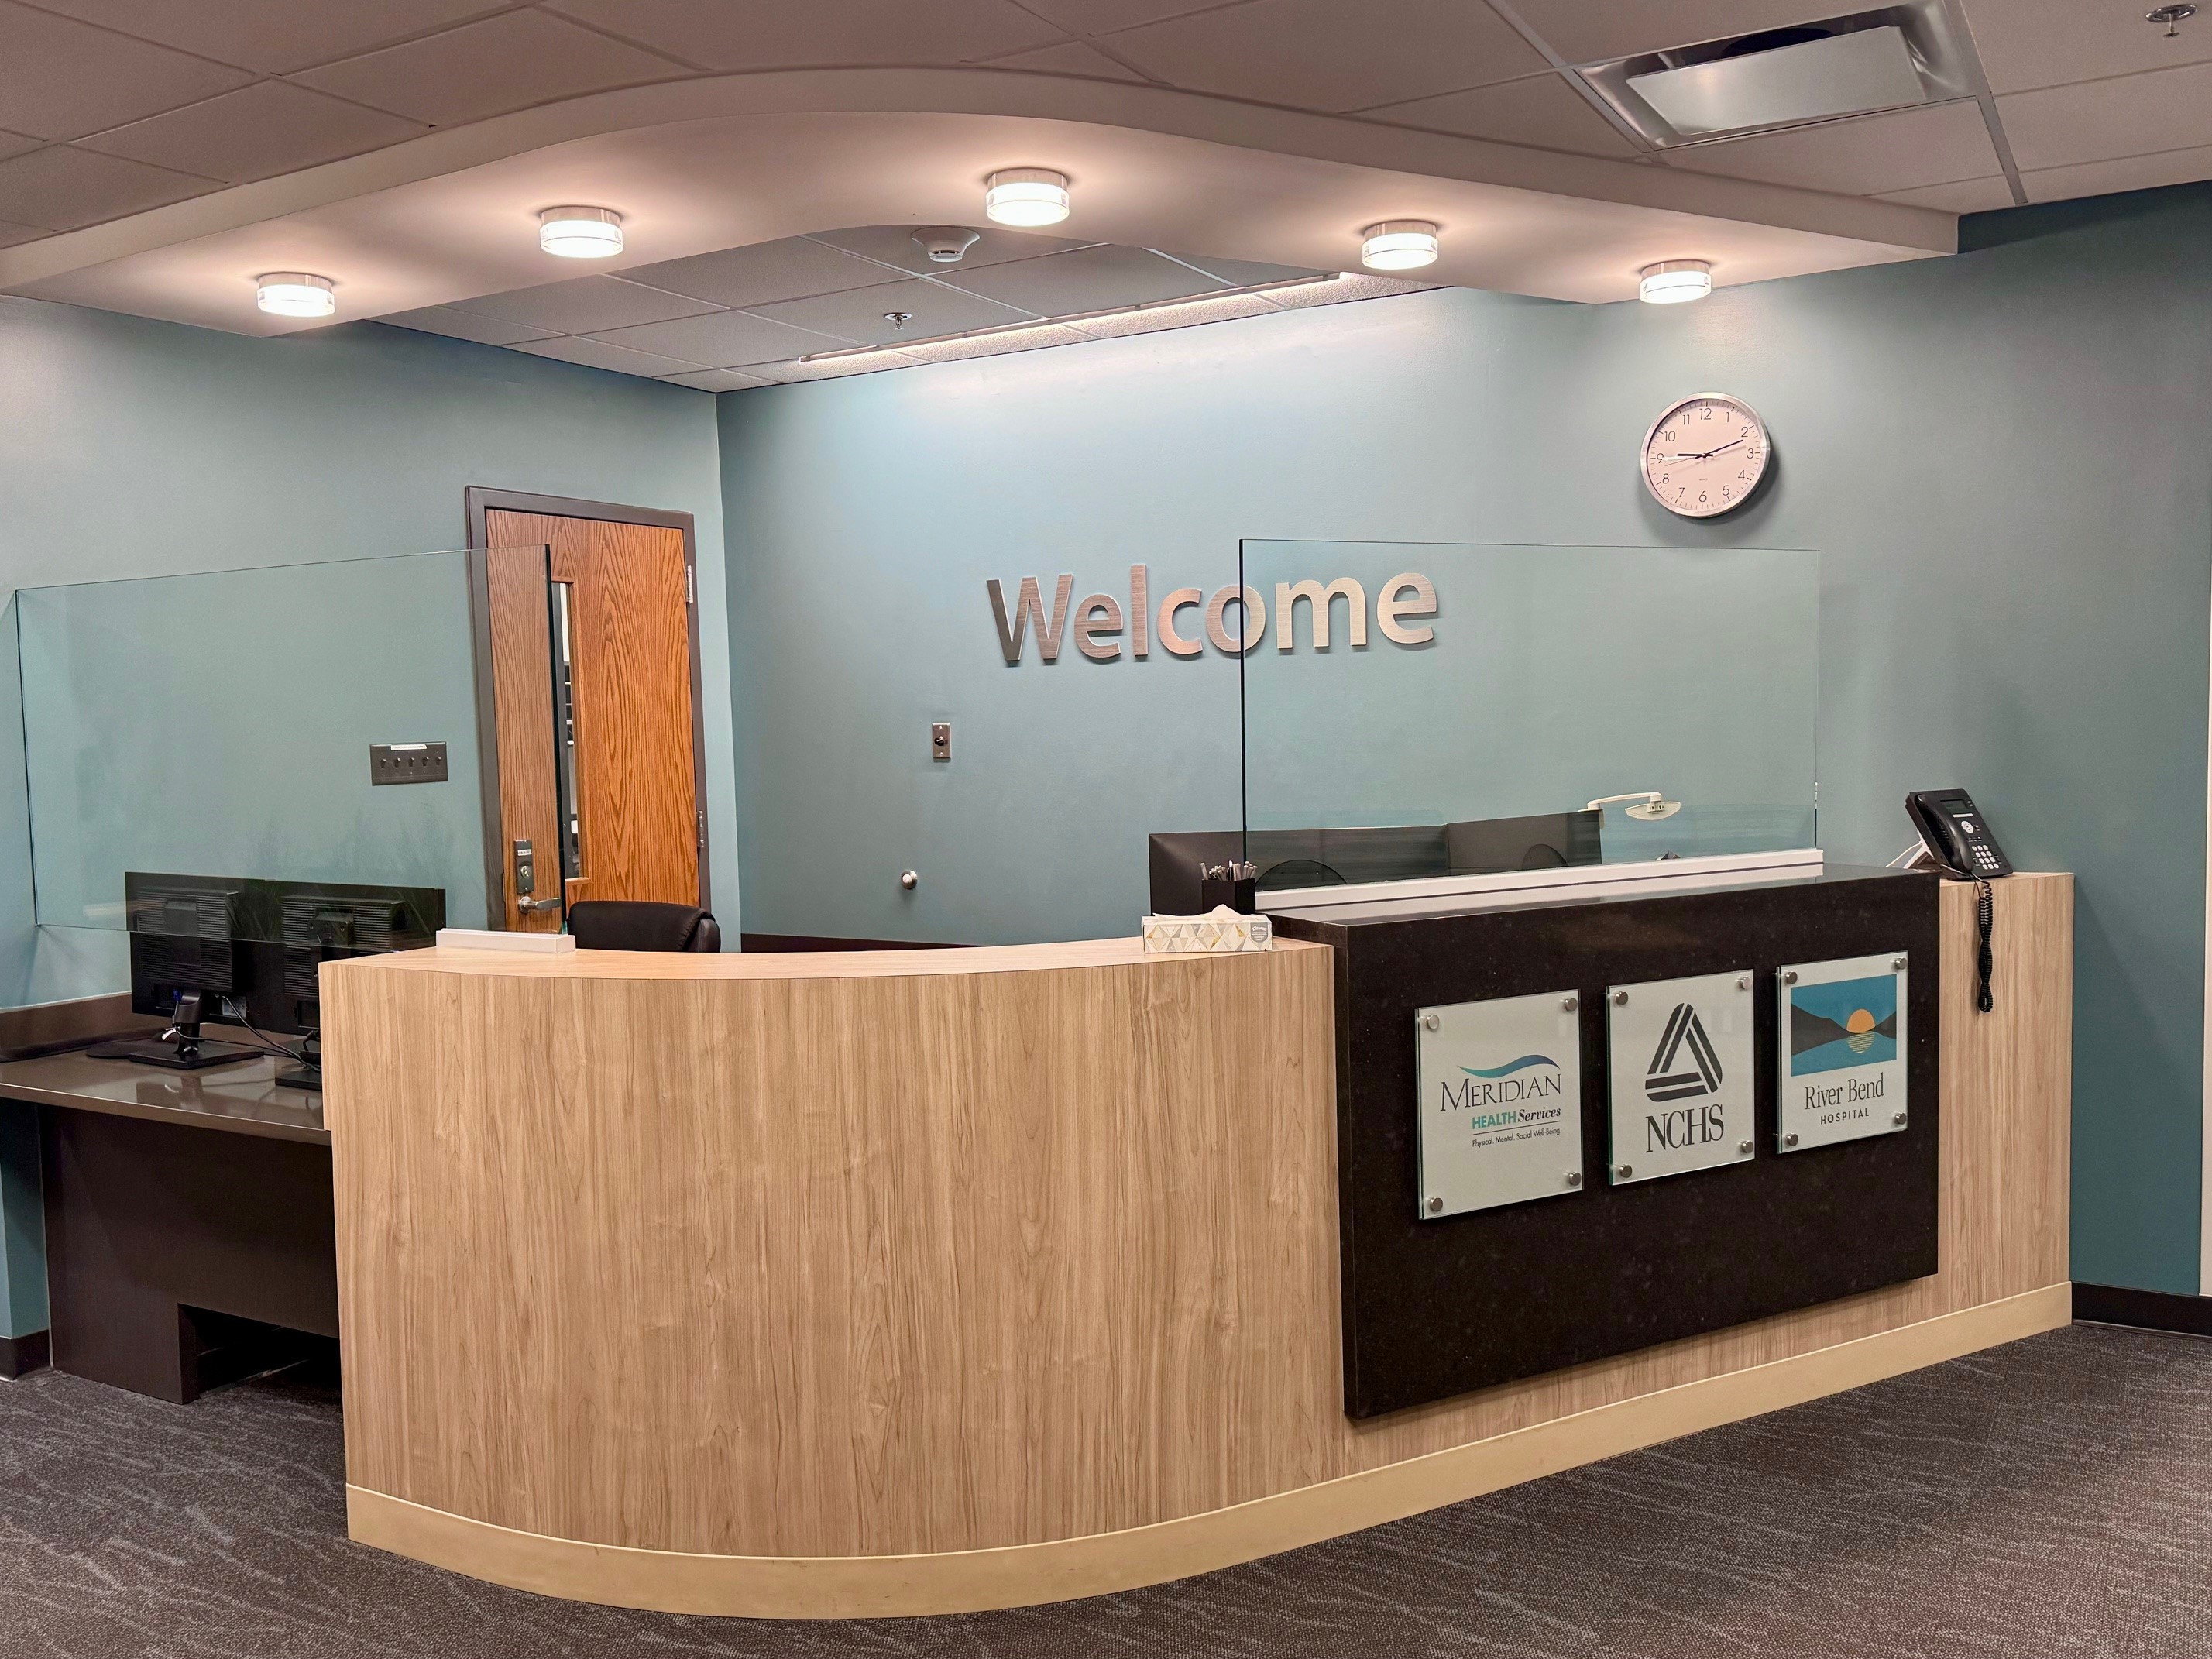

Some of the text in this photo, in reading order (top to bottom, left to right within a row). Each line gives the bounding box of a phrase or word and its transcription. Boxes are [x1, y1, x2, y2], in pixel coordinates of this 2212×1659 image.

[1682, 414, 1690, 425] 11
[1699, 408, 1712, 421] 12
[1726, 411, 1729, 423] 1
[1664, 431, 1676, 442] 10
[1740, 426, 1749, 438] 2
[1656, 453, 1664, 464] 9
[1747, 448, 1754, 459] 3
[1662, 473, 1670, 484] 8
[1737, 469, 1745, 480] 4
[1678, 487, 1685, 497] 7
[1698, 490, 1707, 503] 6
[1722, 485, 1729, 496] 5
[986, 564, 1438, 662] Welcome
[1440, 1073, 1561, 1111] MERIDIAN
[1804, 1072, 1885, 1110] River Bend
[1820, 1108, 1870, 1125] HOSPITAL
[1645, 1104, 1724, 1153] NCHS
[1472, 1136, 1494, 1148] Physical.
[1495, 1133, 1515, 1143] Mental.
[1516, 1130, 1533, 1140] Social
